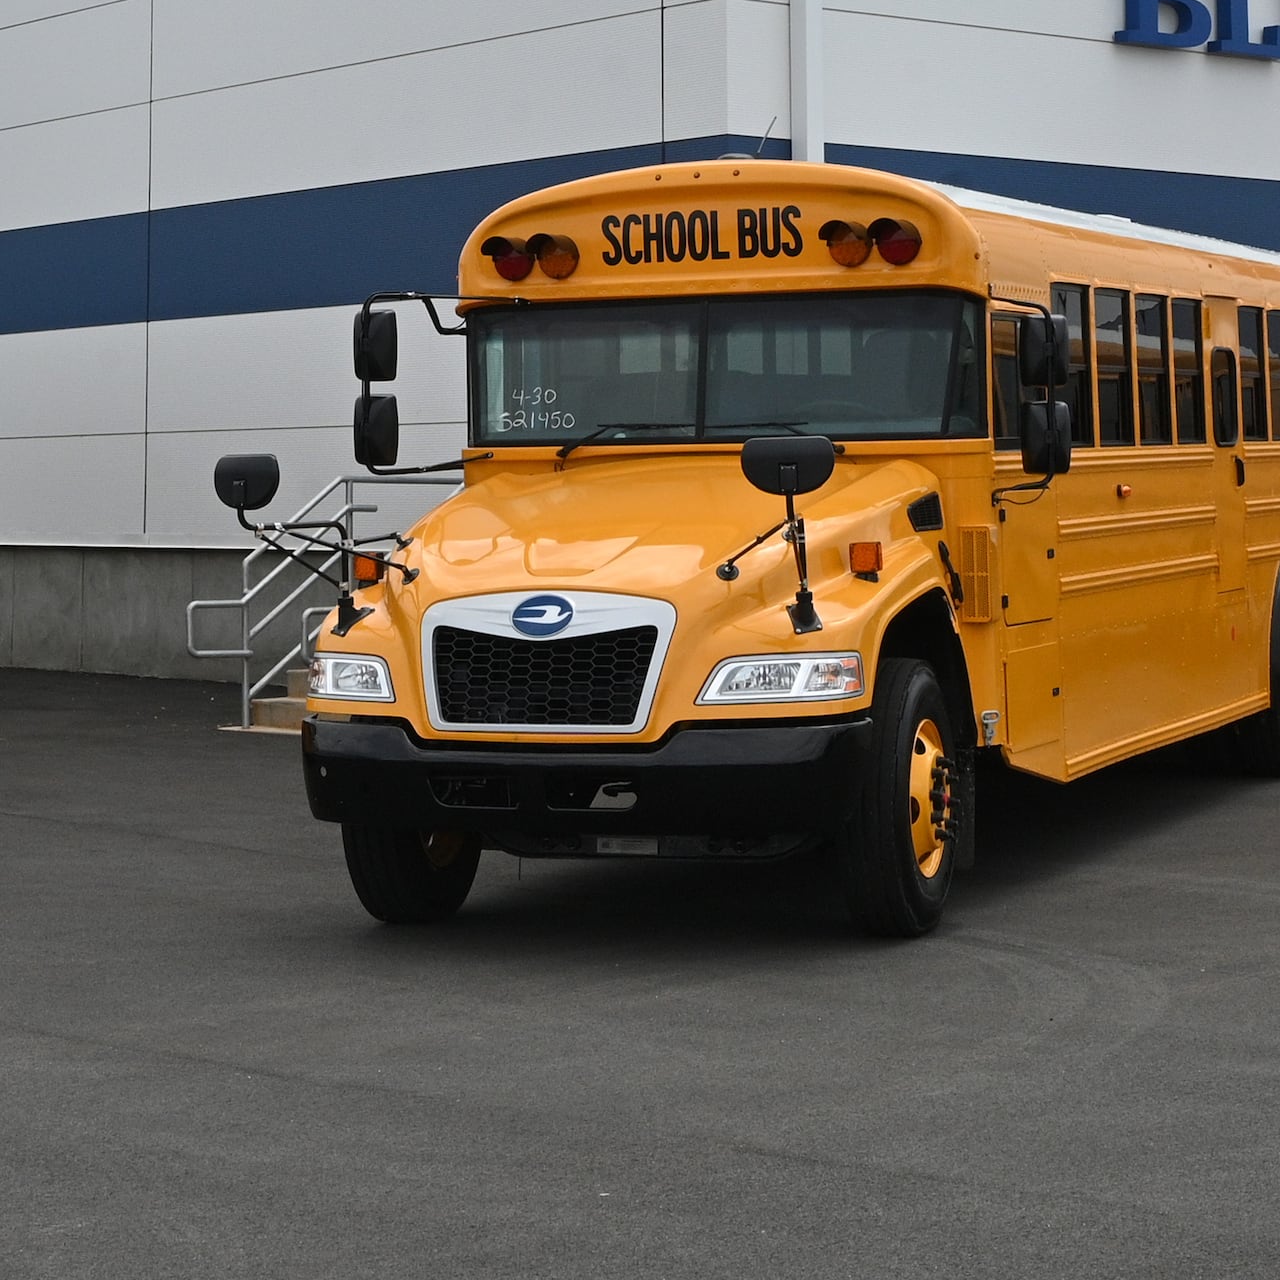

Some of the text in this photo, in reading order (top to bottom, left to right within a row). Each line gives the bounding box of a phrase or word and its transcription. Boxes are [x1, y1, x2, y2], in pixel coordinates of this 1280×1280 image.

[601, 205, 803, 266] SCHOOL BUS
[512, 386, 557, 405] 4-30
[496, 410, 576, 432] 521450
